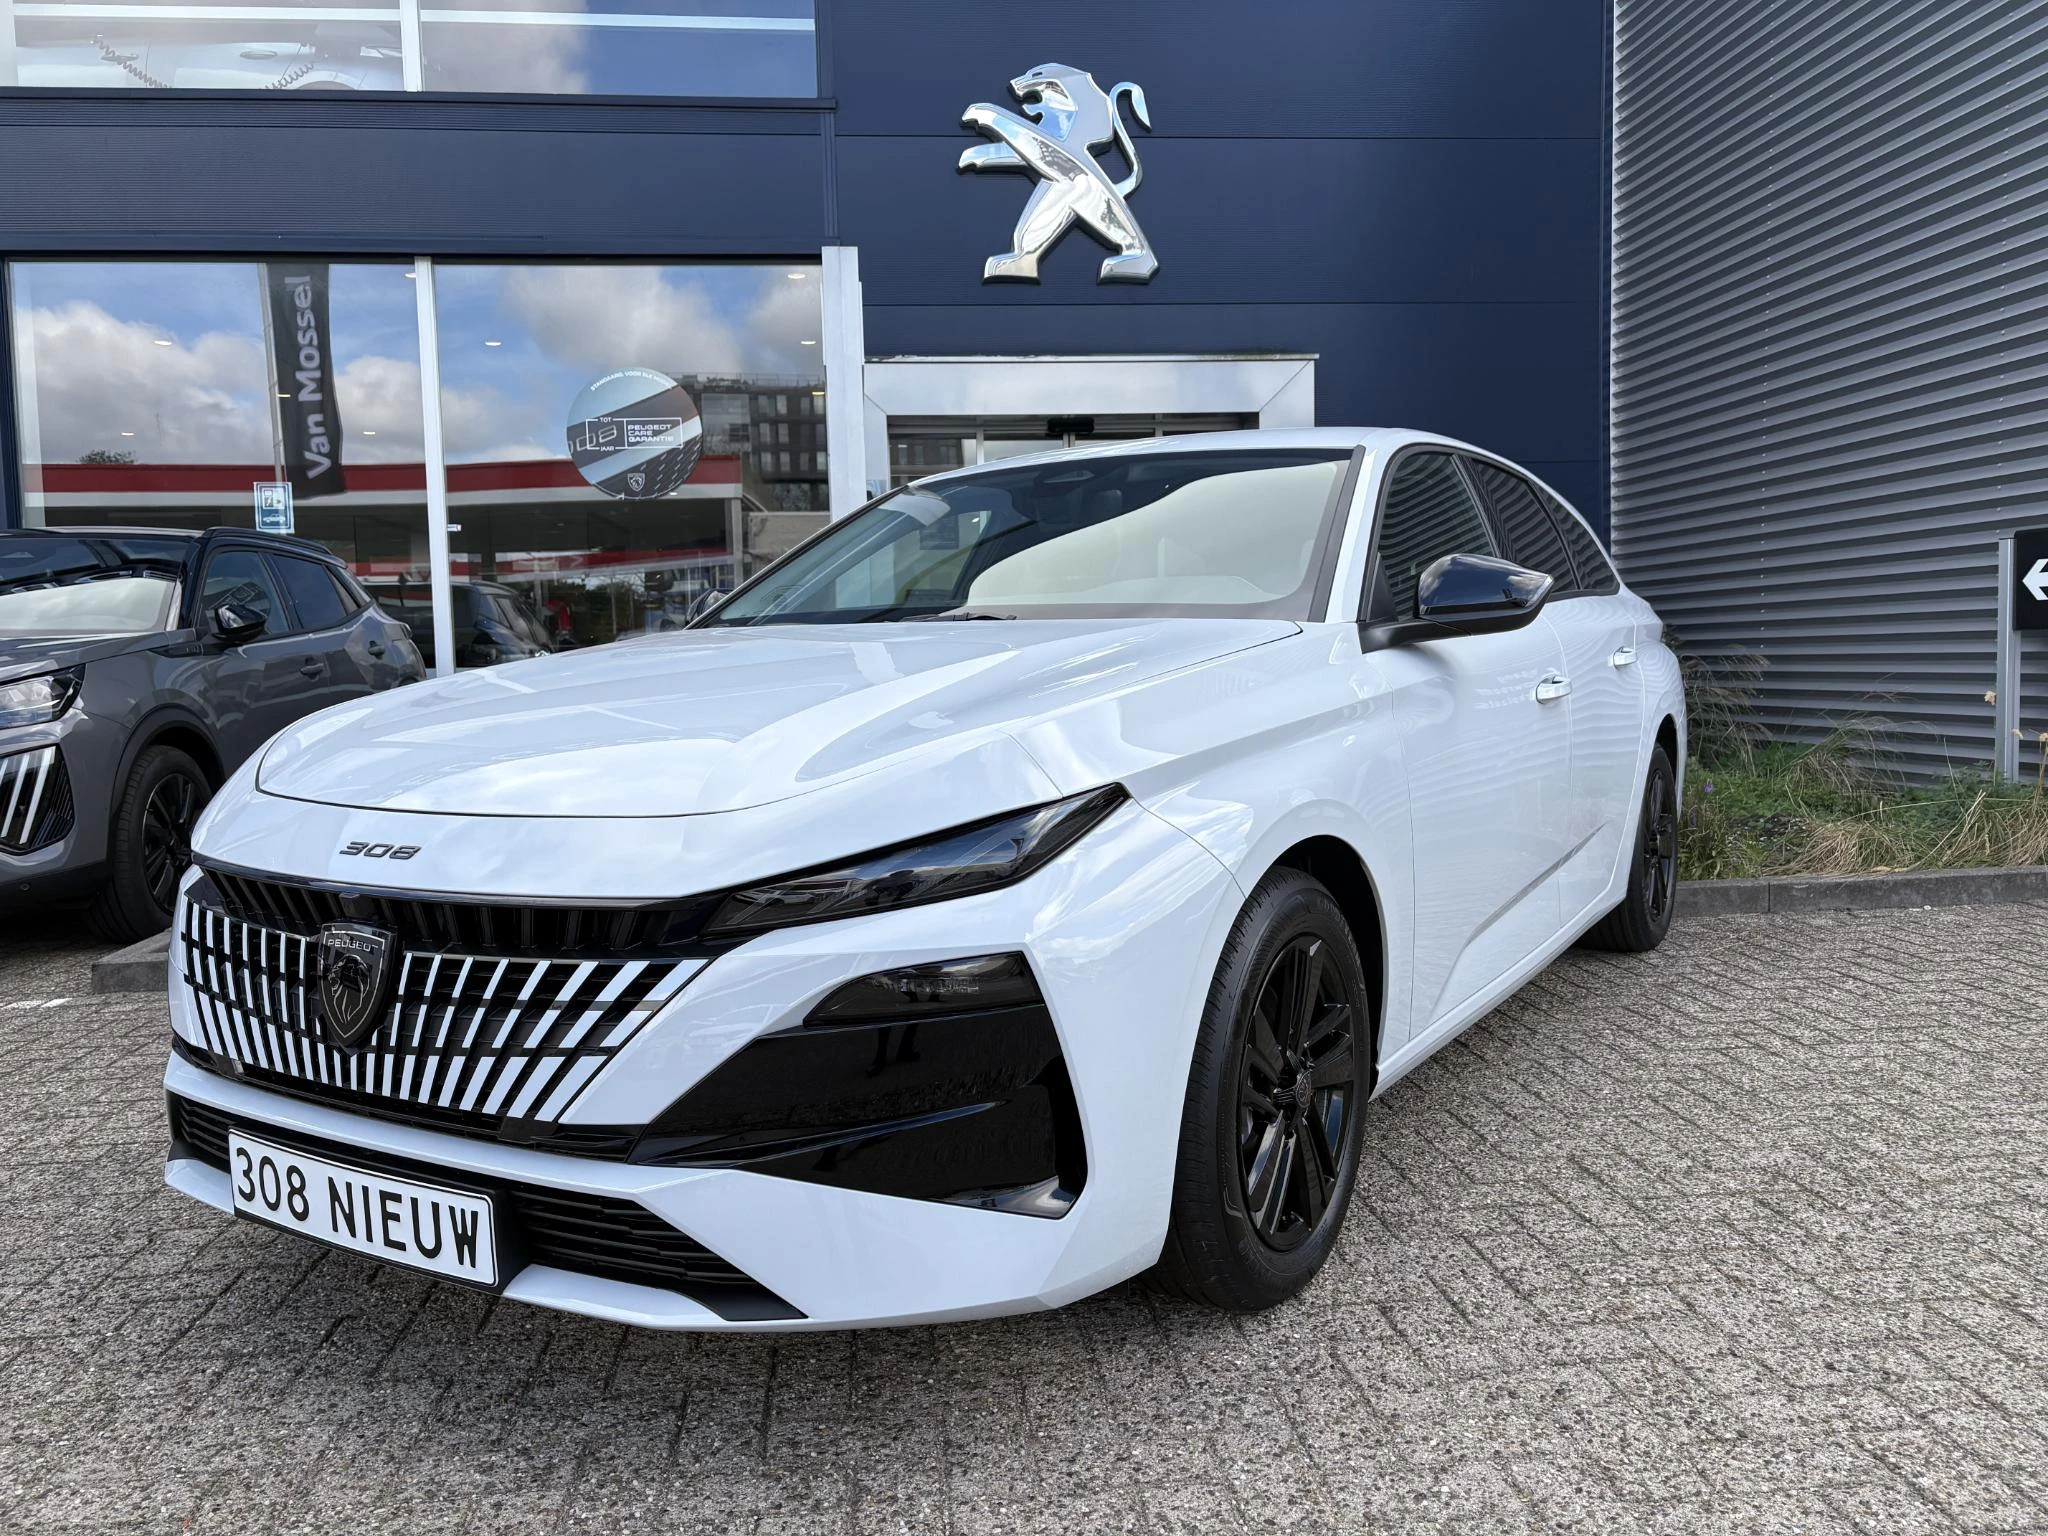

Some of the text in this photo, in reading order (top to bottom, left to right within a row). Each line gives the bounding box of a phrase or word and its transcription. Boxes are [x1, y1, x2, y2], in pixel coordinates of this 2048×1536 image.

[284, 275, 332, 479] Van Mossel
[339, 841, 422, 860] 308
[328, 939, 379, 952] PEUGEOT
[236, 1147, 479, 1268] 308 NIEUW
